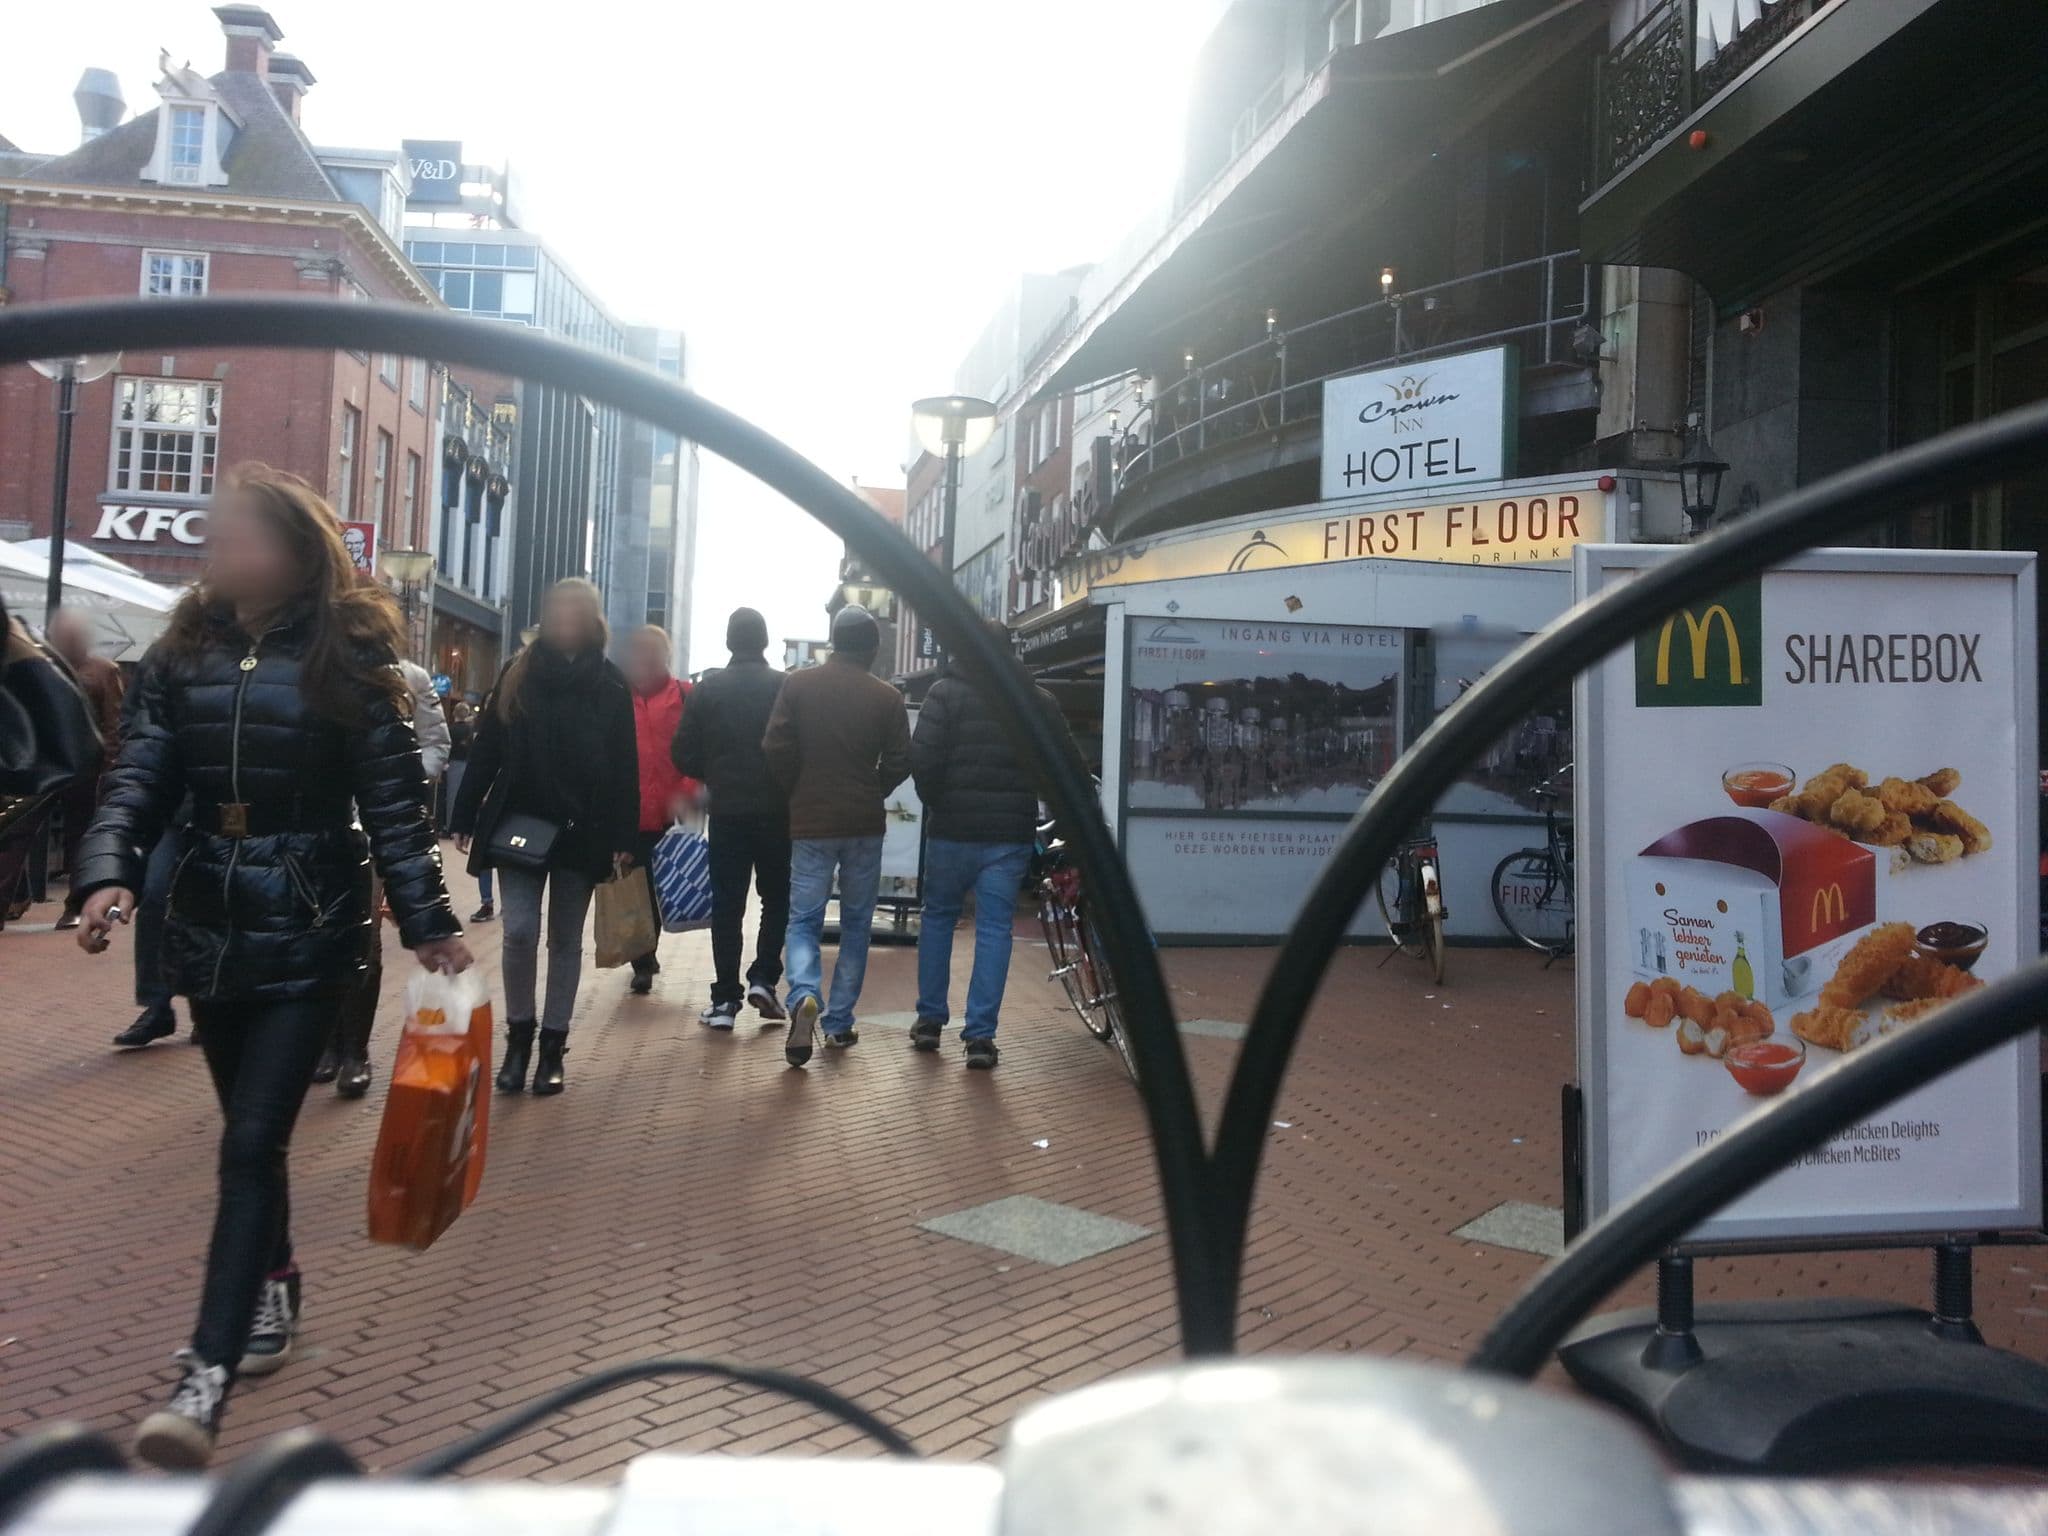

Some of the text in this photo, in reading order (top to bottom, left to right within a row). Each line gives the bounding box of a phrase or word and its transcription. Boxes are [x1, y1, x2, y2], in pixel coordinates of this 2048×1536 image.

[409, 158, 457, 180] V&D
[1359, 393, 1460, 424] Crown
[1343, 437, 1477, 488] HOTEL
[91, 505, 209, 545] KFC
[1324, 496, 1580, 559] FIRST FLOOR
[1472, 547, 1559, 564] DRINK
[1221, 626, 1399, 647] INGANG VIA HOTEL
[1785, 633, 1983, 684] SHAREBOX
[1165, 831, 1337, 844] HIER GEEN FIETSEN PLAAT
[1174, 844, 1206, 854] DEZE
[1213, 845, 1266, 855] WORDEN
[1502, 885, 1553, 905] FIRS
[1663, 908, 1715, 929] Samen
[1672, 928, 1712, 946] lekker
[1675, 946, 1727, 969] genieten
[1891, 1120, 1941, 1141] Delights
[1854, 1146, 1901, 1163] McBites
